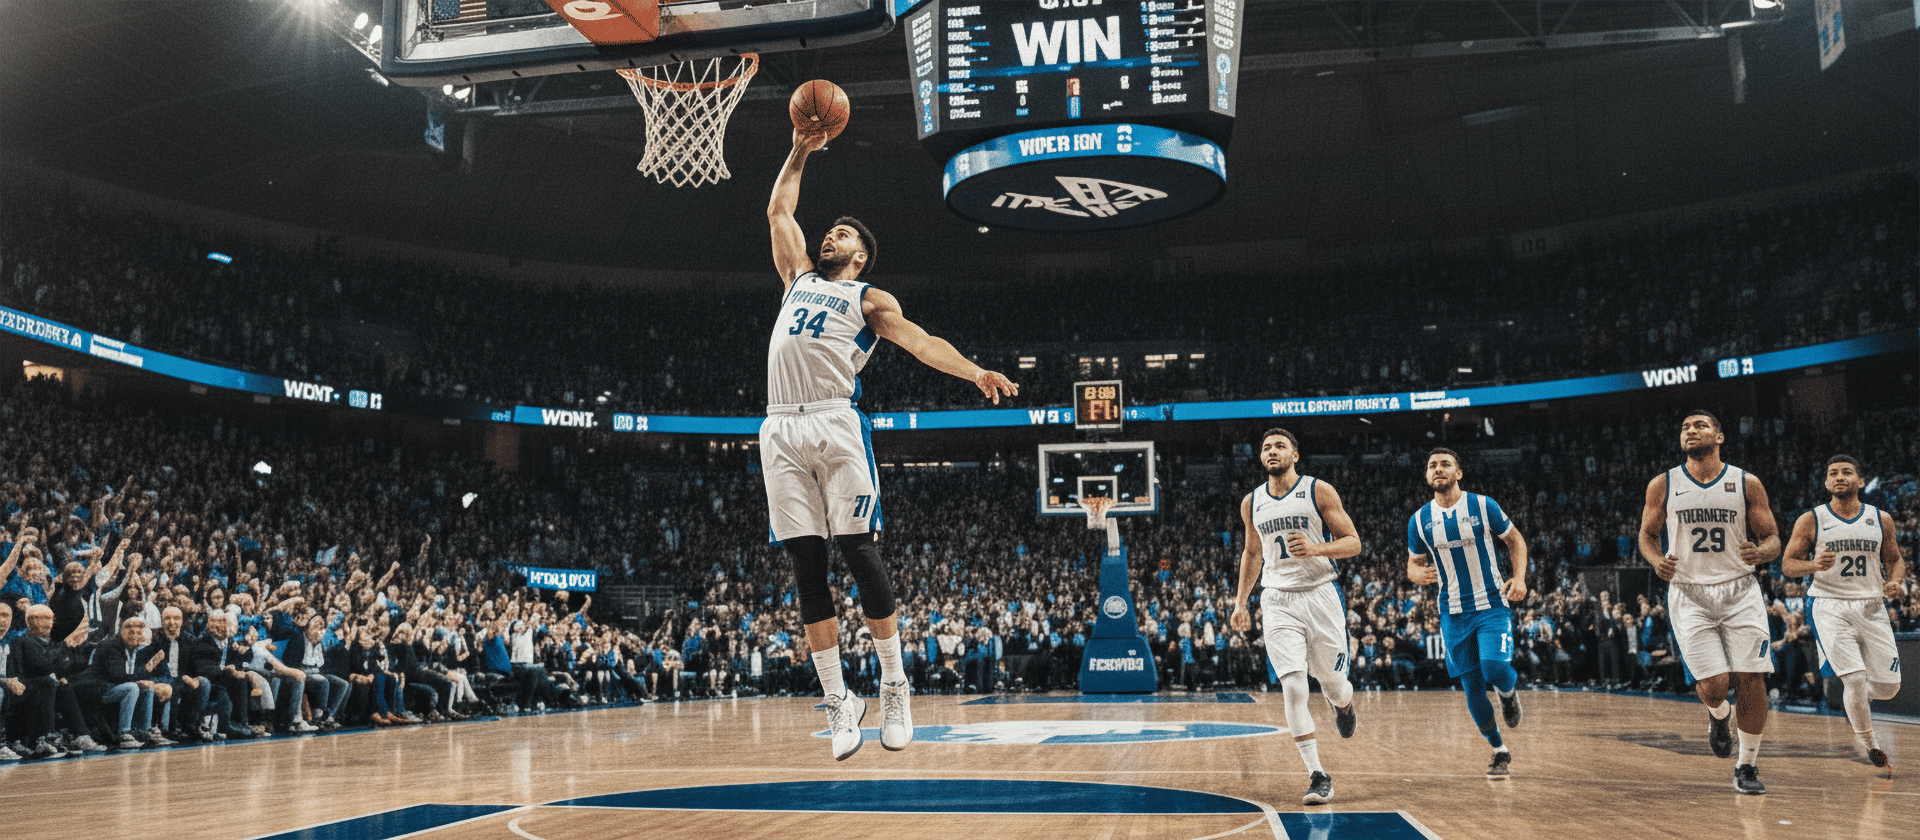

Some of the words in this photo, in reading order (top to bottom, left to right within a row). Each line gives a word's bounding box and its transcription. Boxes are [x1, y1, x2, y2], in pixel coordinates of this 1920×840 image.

[1012, 16, 1121, 66] WIN
[789, 308, 828, 339] 34
[1691, 527, 1725, 553] 29
[1840, 555, 1867, 577] 29
